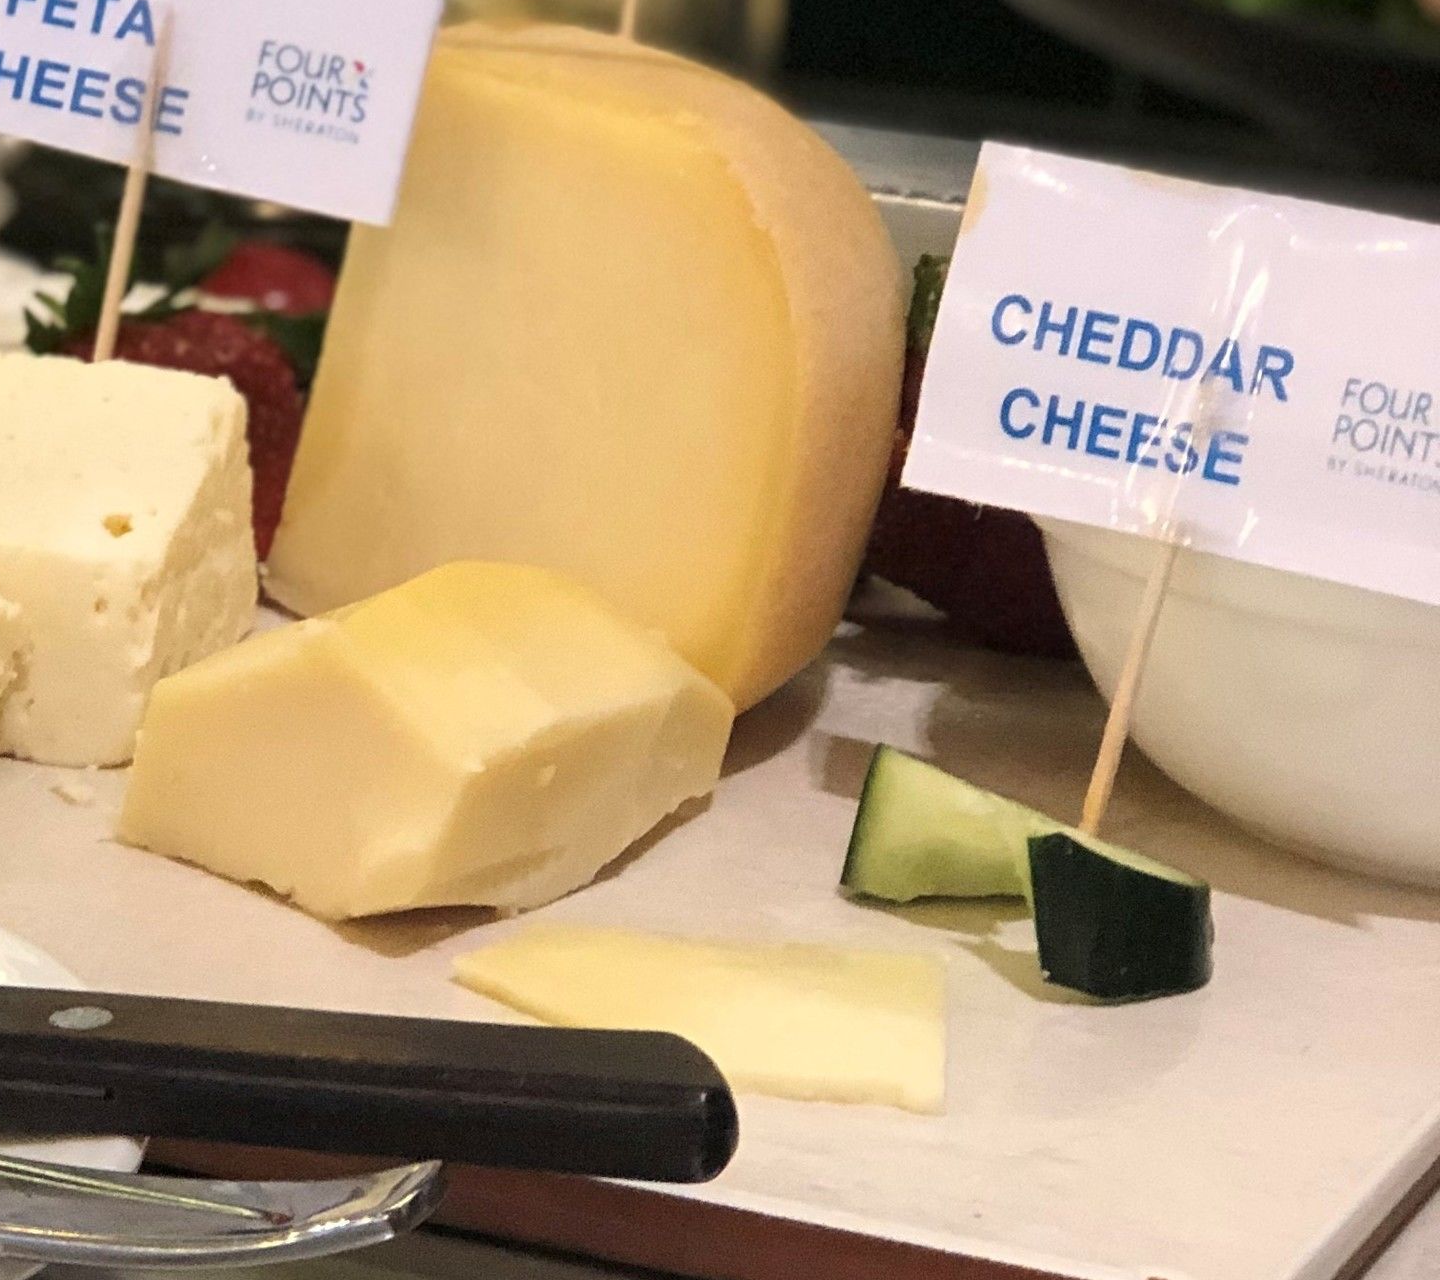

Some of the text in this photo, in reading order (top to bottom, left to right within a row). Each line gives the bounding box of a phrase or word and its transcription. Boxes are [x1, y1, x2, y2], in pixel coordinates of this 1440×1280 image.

[258, 40, 345, 84] FOUR
[251, 71, 367, 123] POINTS
[991, 294, 1296, 402] CHEDDAR
[1341, 377, 1433, 426] FOUR
[999, 388, 1249, 486] CHEESE
[1332, 414, 1440, 468] POINT
